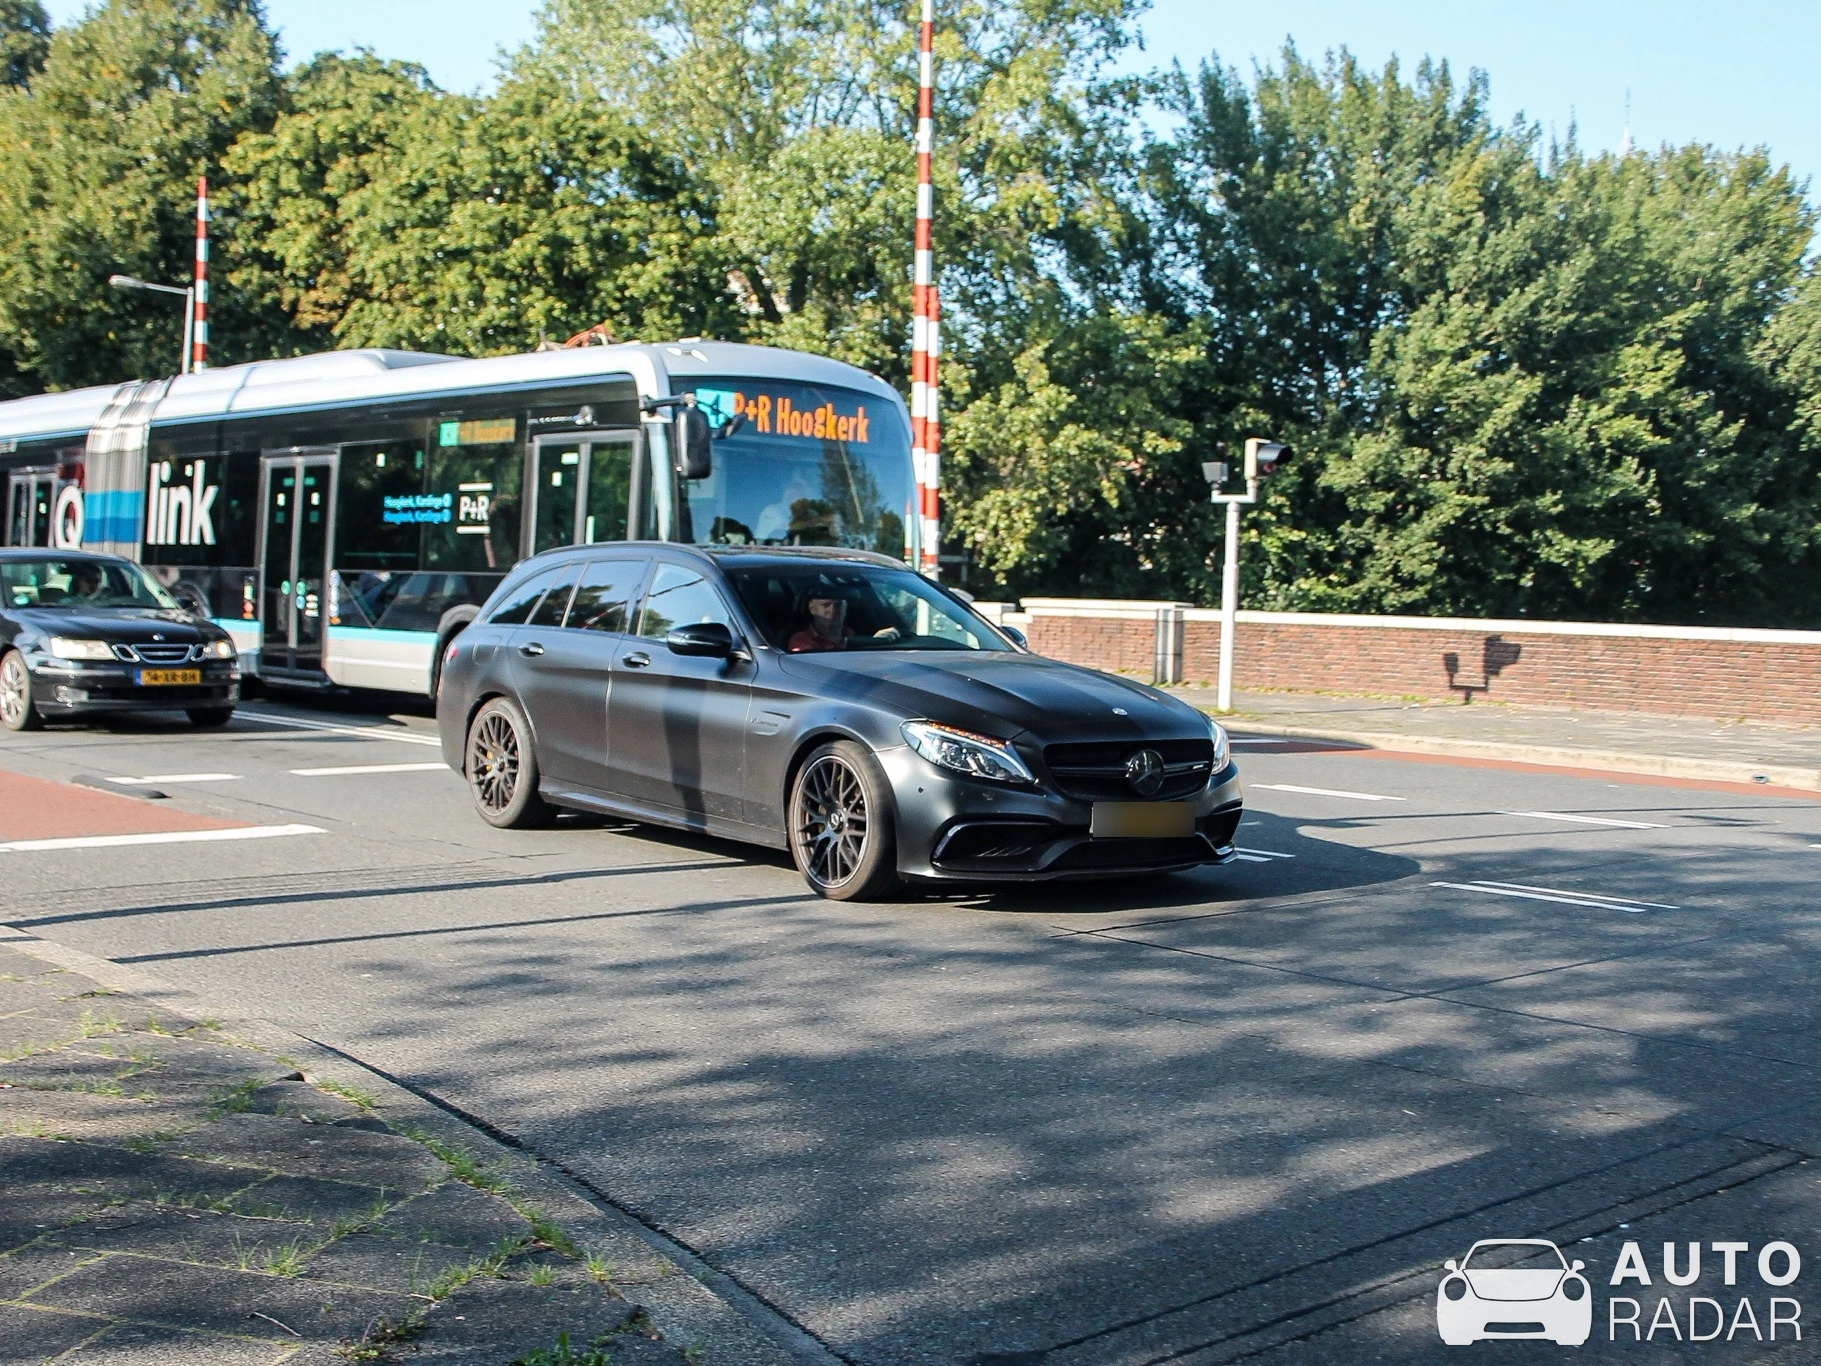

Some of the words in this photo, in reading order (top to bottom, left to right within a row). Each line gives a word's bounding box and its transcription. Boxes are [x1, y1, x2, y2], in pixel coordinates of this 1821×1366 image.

[776, 397, 869, 443] Hoogkerk
[55, 485, 84, 549] Q
[146, 460, 218, 545] link
[458, 495, 490, 521] P+R
